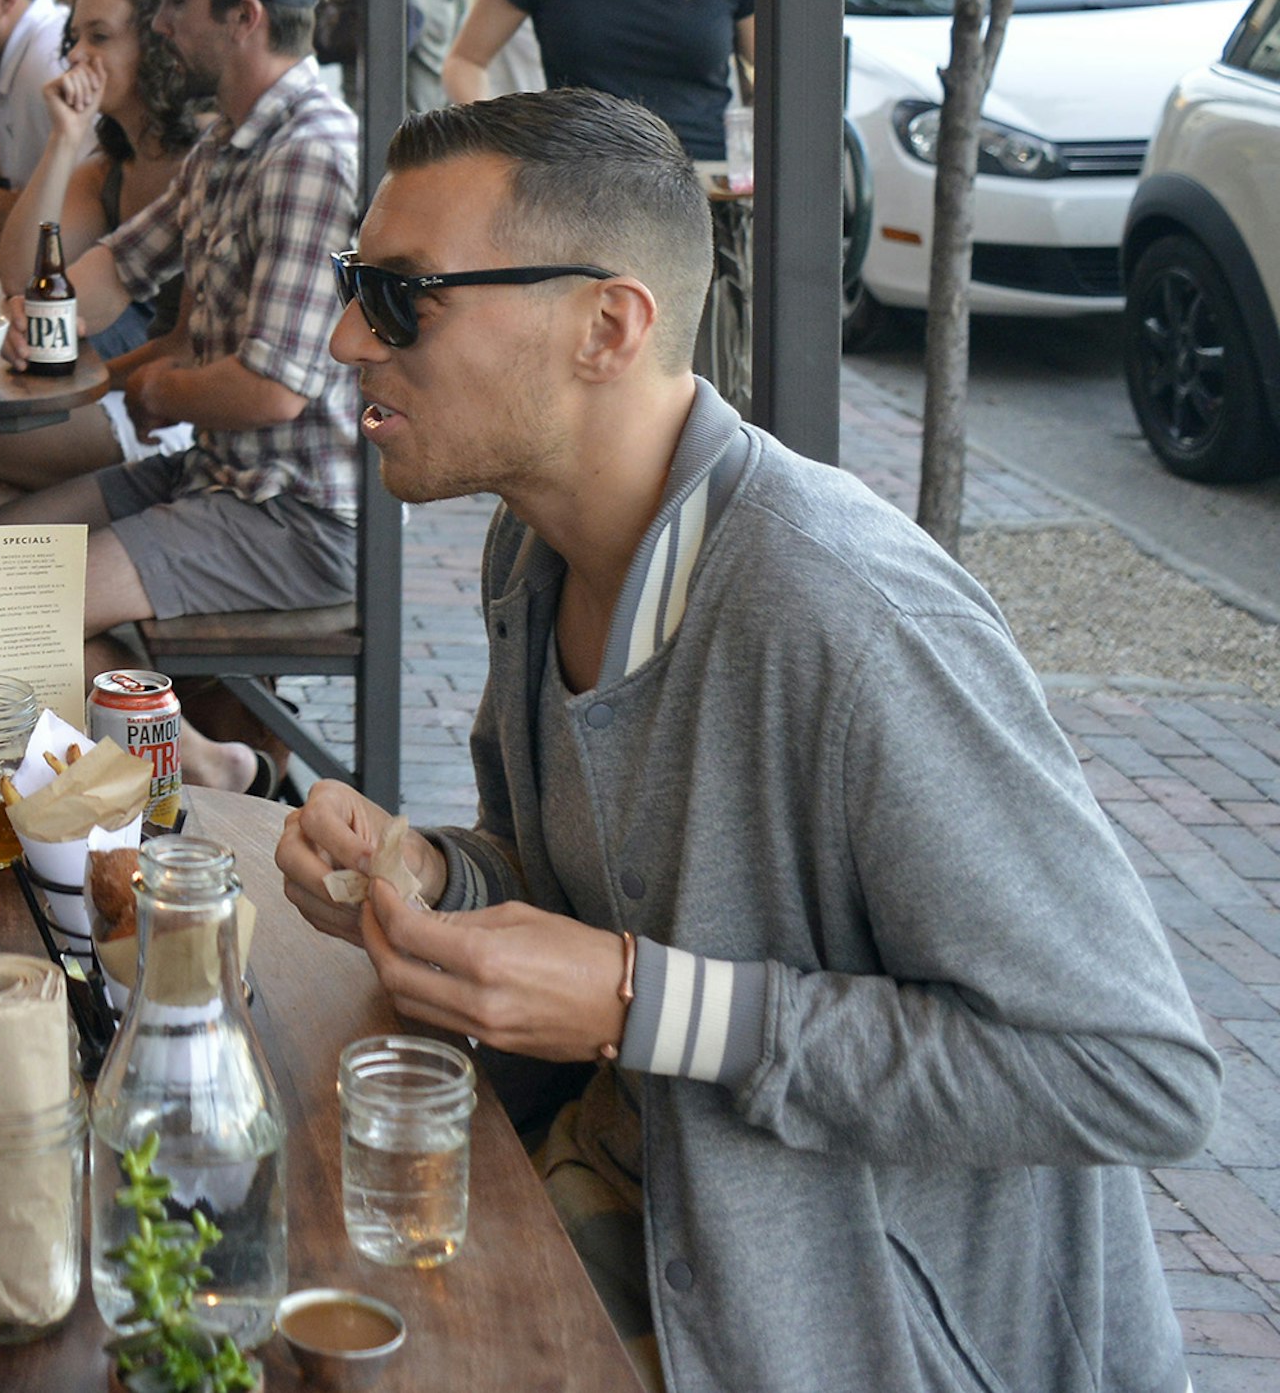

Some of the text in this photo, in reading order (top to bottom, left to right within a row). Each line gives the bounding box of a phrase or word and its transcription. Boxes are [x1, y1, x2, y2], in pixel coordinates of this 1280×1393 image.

[27, 316, 70, 348] IPA
[3, 536, 52, 545] SPECIALS
[127, 720, 181, 745] PAMOL
